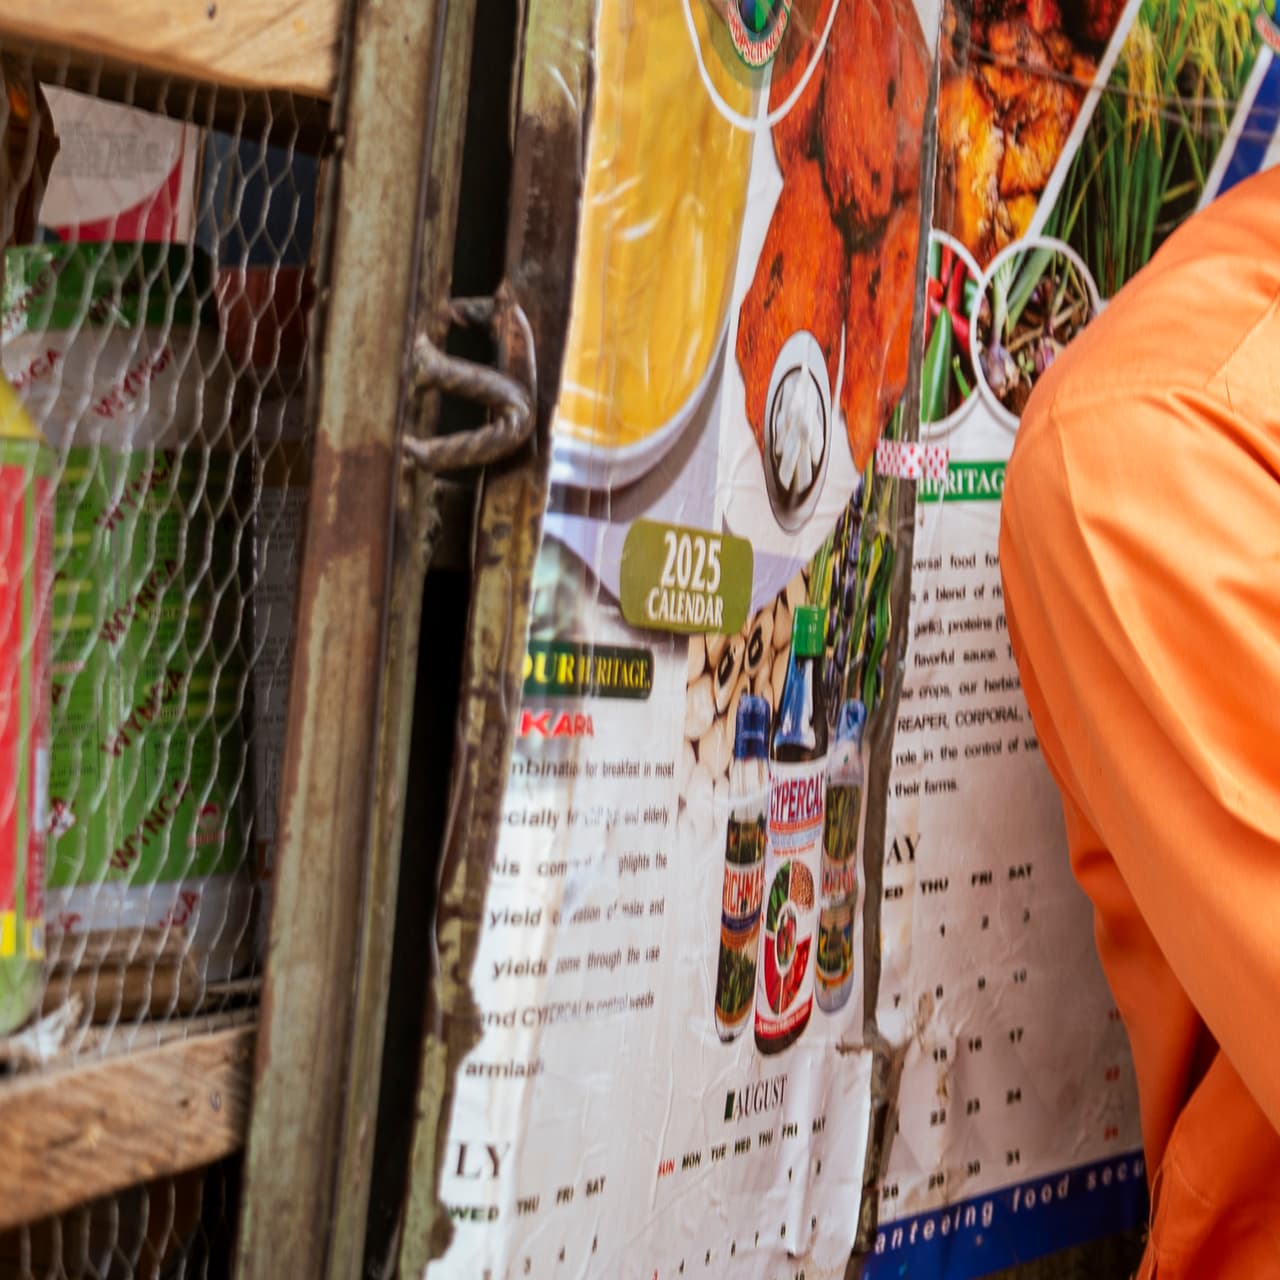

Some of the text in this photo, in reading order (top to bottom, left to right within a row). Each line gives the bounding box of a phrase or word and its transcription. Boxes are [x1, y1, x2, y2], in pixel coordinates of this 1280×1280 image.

[660, 530, 722, 590] 2025
[950, 552, 976, 568] food
[648, 587, 724, 626] CALENDAR
[936, 585, 966, 602] blend
[974, 584, 985, 599] of
[948, 615, 993, 635] proteins
[914, 647, 955, 669] flavorful
[959, 680, 977, 696] our
[896, 736, 1019, 767] role in the control of
[585, 758, 675, 779] for breakfast in most
[895, 779, 921, 798] their
[655, 848, 668, 870] the
[920, 878, 950, 894] THU
[970, 871, 993, 887] FRI
[1008, 865, 1033, 881] SAT
[491, 905, 542, 931] yield
[650, 895, 664, 915] and
[587, 948, 622, 972] through
[627, 944, 640, 964] the
[645, 944, 660, 963] use
[630, 989, 654, 1011] weeds
[1009, 1026, 1024, 1044] 17
[734, 1072, 787, 1119] AUGUST
[967, 1097, 981, 1116] 23
[1006, 1087, 1022, 1105] 24
[455, 1142, 510, 1179] LY
[657, 1157, 675, 1178] SUN
[682, 1150, 702, 1171] MON
[711, 1142, 727, 1162] TUE
[734, 1135, 752, 1155] WED
[758, 1127, 774, 1149] THU
[928, 1148, 1021, 1190] 29 30 31
[516, 1195, 540, 1216] THU
[556, 1185, 574, 1206] FRI
[586, 1175, 606, 1198] SAT
[875, 1201, 994, 1255] anteeing
[1012, 1176, 1070, 1213] food
